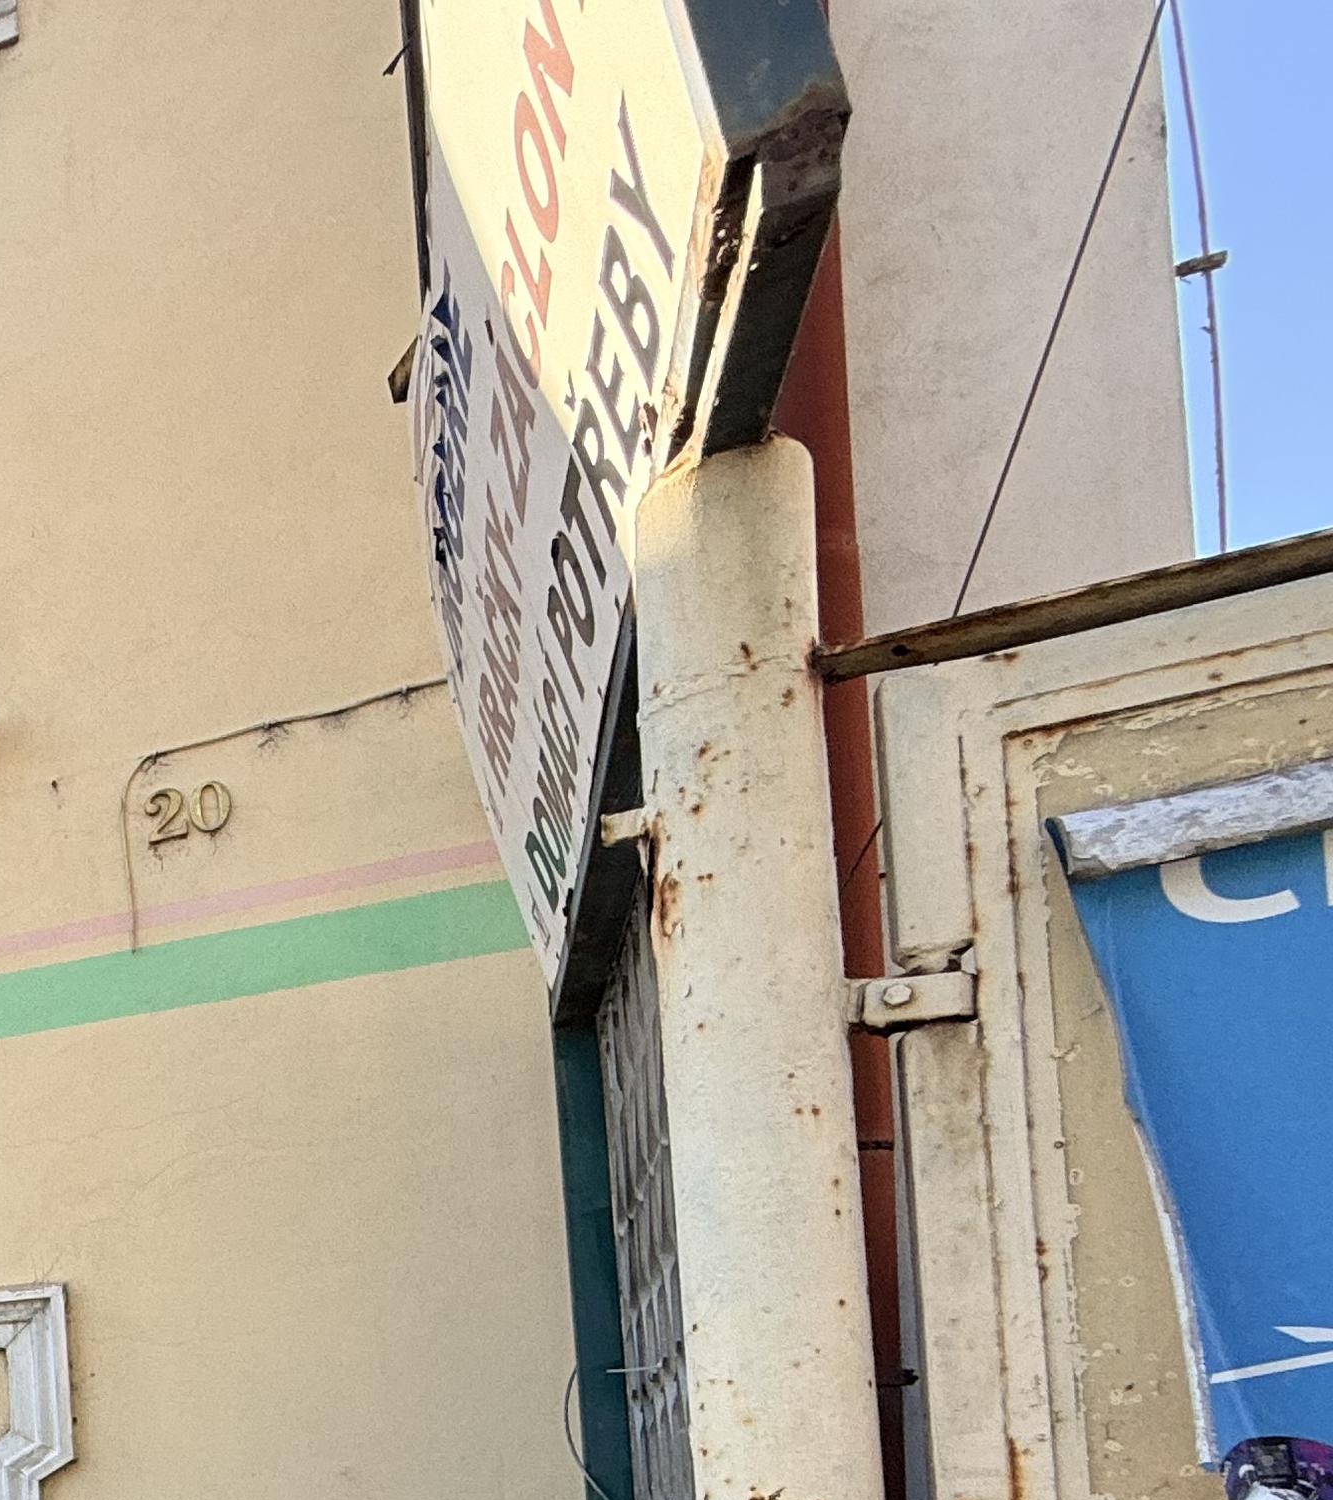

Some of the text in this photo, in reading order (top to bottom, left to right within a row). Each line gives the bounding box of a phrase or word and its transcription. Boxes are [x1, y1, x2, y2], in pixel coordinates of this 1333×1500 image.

[485, 0, 584, 529] ZÁCLON
[525, 87, 675, 914] DOMÁCÍ POTŘEBY
[144, 780, 232, 846] 20
